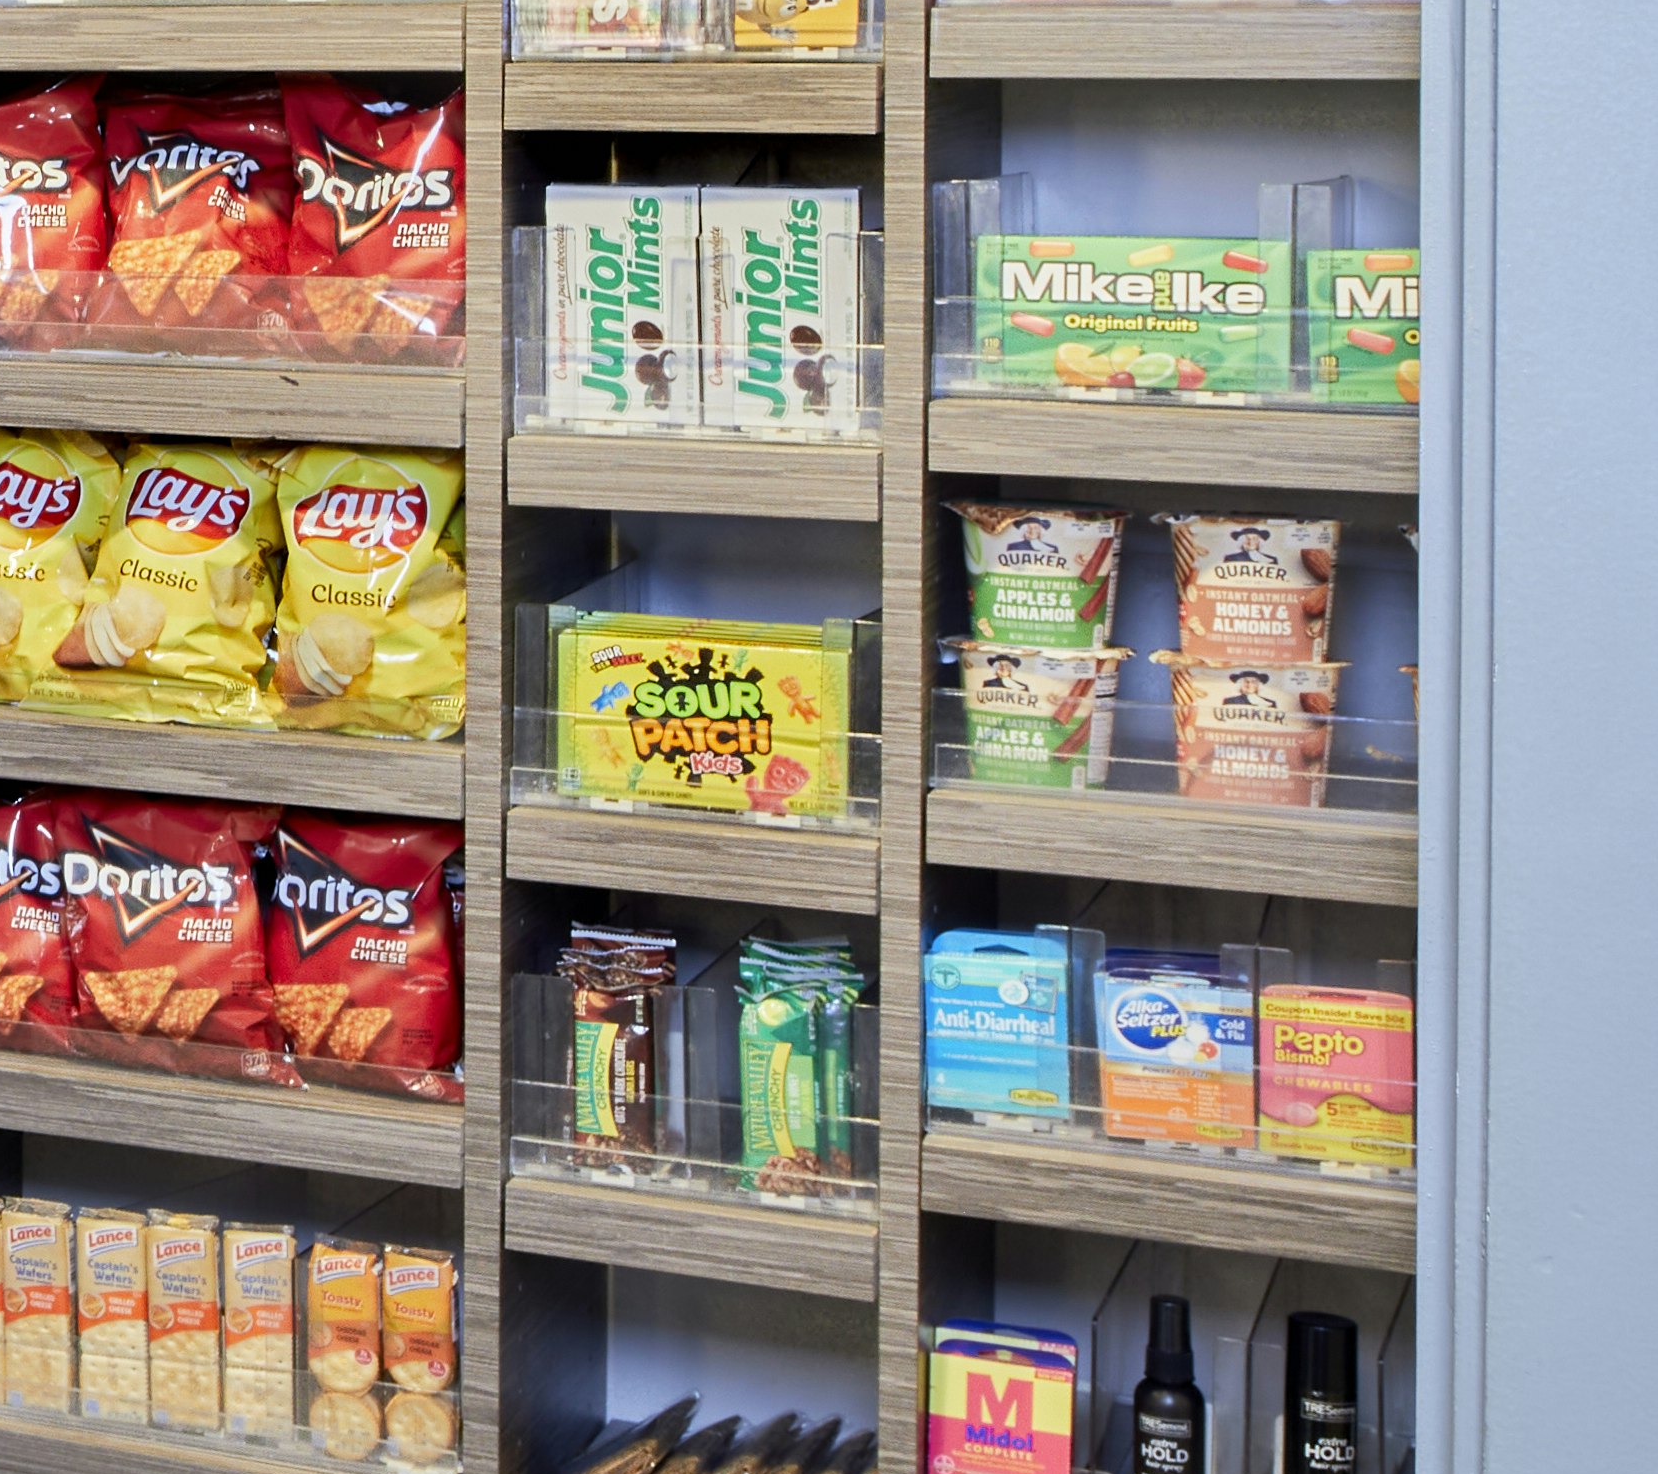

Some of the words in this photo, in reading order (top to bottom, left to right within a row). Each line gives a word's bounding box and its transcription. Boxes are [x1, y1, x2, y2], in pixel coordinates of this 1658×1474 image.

[397, 222, 450, 236] NACHO
[392, 235, 450, 248] CHEESE
[626, 195, 662, 312] Mints
[785, 197, 821, 316] Mints
[1002, 261, 1155, 304] Mike
[1171, 272, 1266, 315] Ike
[1334, 275, 1420, 319] Mi
[577, 224, 631, 415] Junior
[736, 229, 788, 420] Junior
[1064, 314, 1143, 332] Original
[1146, 317, 1199, 333] Fruits
[998, 552, 1067, 570] QUAKER
[119, 557, 199, 594] Classic
[1214, 564, 1288, 582] QUAKER
[989, 576, 1031, 591] INSTANT
[1034, 579, 1080, 592] OATMEAL
[311, 583, 397, 610] Classic
[996, 589, 1057, 607] APPLES
[1059, 592, 1072, 607] &
[993, 604, 1076, 623] CINNAMON
[1215, 603, 1274, 620] HONEY
[1276, 605, 1290, 620] &
[1212, 618, 1293, 636] ALMONDS
[634, 681, 762, 719] SOUR
[631, 717, 771, 756] PATCH
[689, 752, 743, 775] Kids
[63, 852, 236, 904] Doritos
[273, 872, 413, 925] oritos
[182, 917, 233, 931] NACHO
[178, 928, 234, 943] CHEESE
[1122, 1000, 1169, 1014] Alka-
[1266, 1003, 1311, 1014] Coupon
[1313, 1007, 1352, 1017] Inside!
[1355, 1011, 1382, 1020] Save
[934, 1007, 1055, 1036] Anti-Diarrheal
[1117, 1013, 1178, 1028] Seltzer
[1219, 1019, 1245, 1030] Cold
[1151, 1026, 1186, 1037] PLUS
[1215, 1029, 1226, 1039] &
[1228, 1030, 1245, 1040] Flu
[1275, 1024, 1364, 1055] Pepto
[1275, 1049, 1329, 1066] Bismol
[595, 1049, 607, 1109] CRUNCHY
[1274, 1076, 1373, 1093] CHEWABLES
[10, 1226, 52, 1242] Lance
[322, 1290, 362, 1307] Toasty
[394, 1301, 435, 1319] Toasty
[966, 1371, 1034, 1430] M
[966, 1425, 1034, 1452] Midol
[1150, 1439, 1177, 1449] extra
[964, 1443, 1033, 1461] COMPLETE
[1141, 1444, 1189, 1463] HOLD
[1305, 1443, 1355, 1461] HOLD
